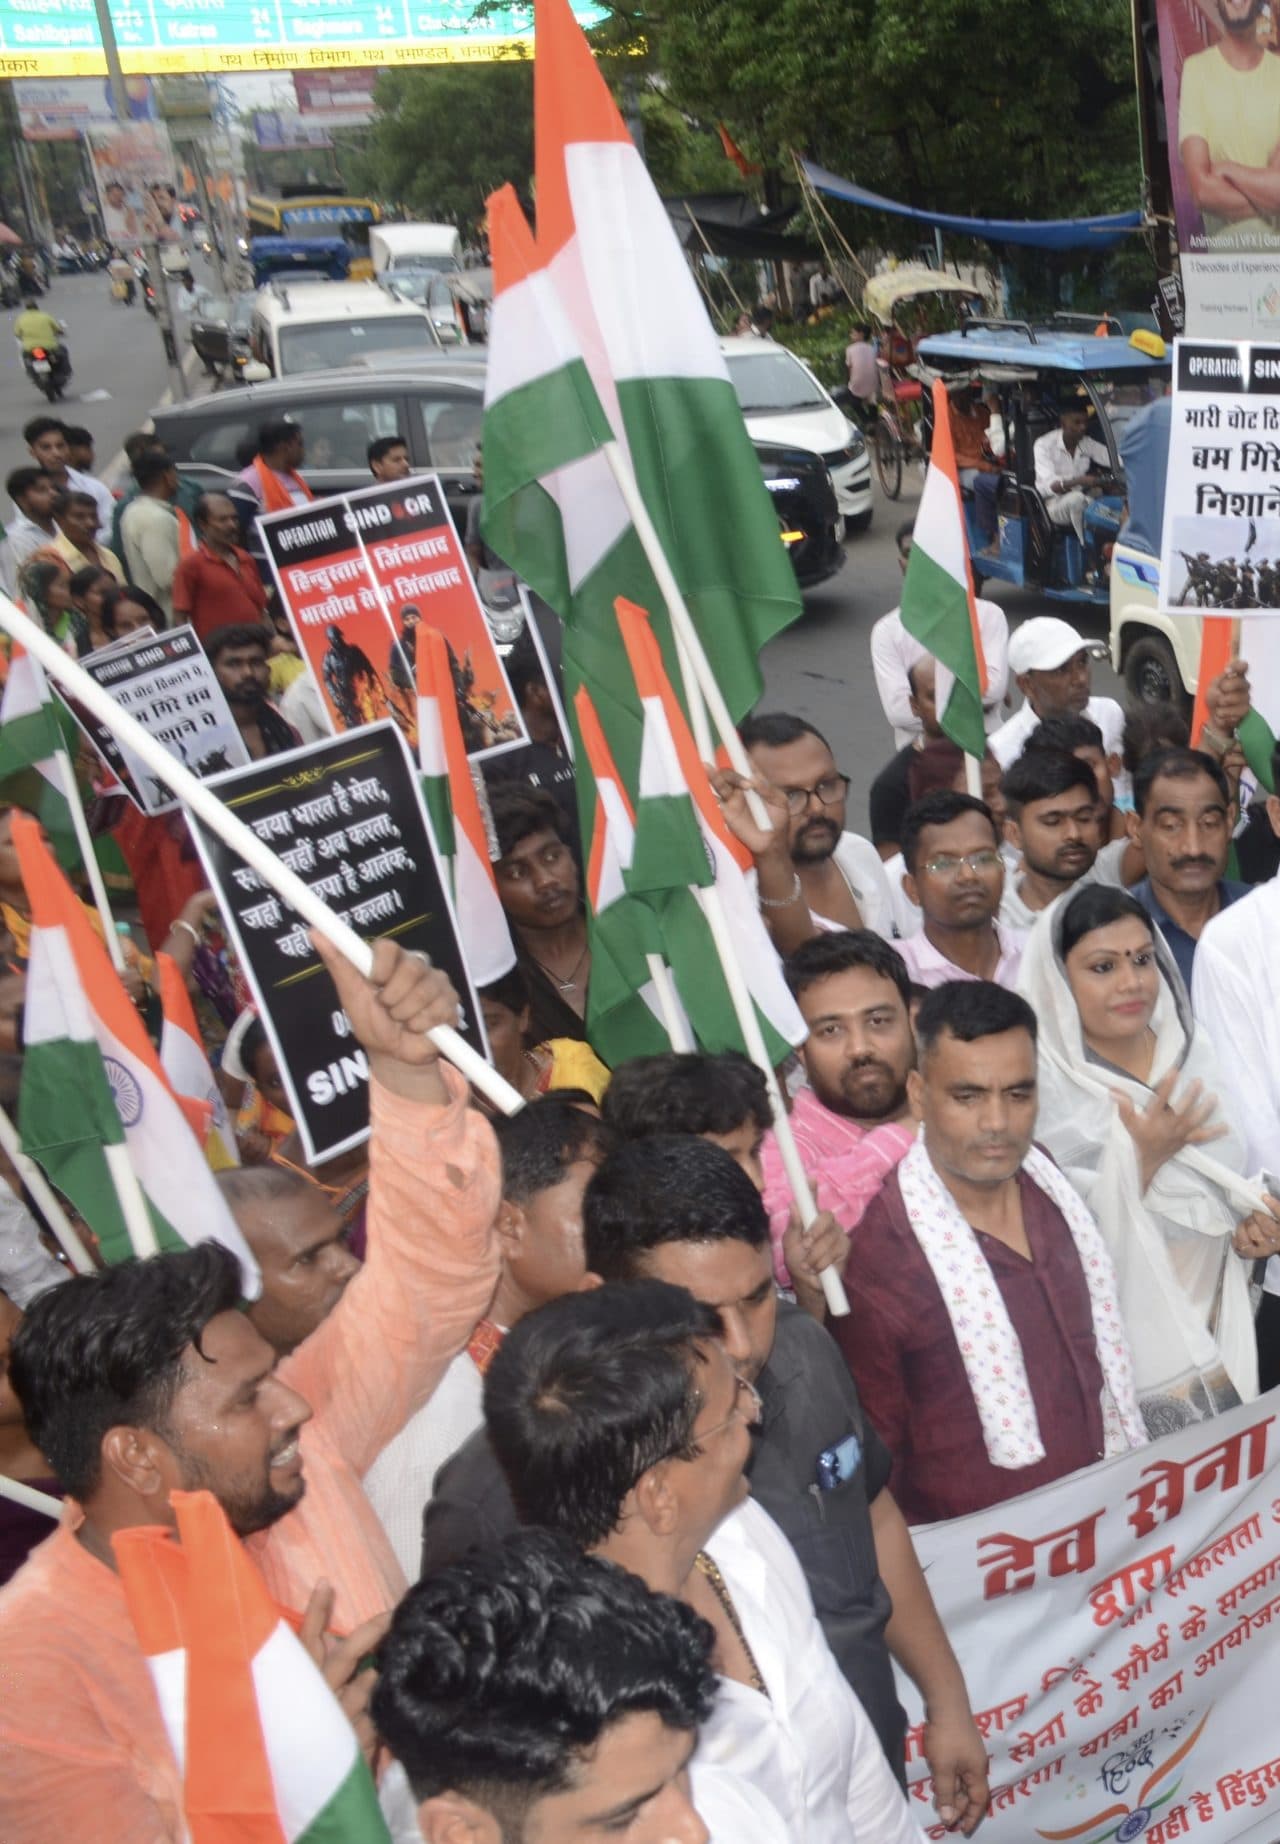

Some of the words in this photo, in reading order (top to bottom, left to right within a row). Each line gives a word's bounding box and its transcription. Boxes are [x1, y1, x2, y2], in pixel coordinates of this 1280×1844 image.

[286, 207, 366, 223] VINAY
[1189, 234, 1234, 249] Animation
[1189, 357, 1243, 378] OPERATION
[1185, 405, 1221, 429] मारी
[1227, 405, 1258, 430] चोट
[1192, 446, 1233, 471] बम
[277, 518, 338, 551] OPERATION
[373, 535, 450, 570] जिंदाबाद
[299, 595, 359, 625] भारतीय
[394, 567, 463, 600] जिंदाबाद
[252, 811, 294, 842] नया
[292, 792, 338, 827] भारत
[332, 781, 353, 816] है
[347, 776, 390, 804] मेरा,
[317, 829, 350, 861] अब
[345, 812, 402, 848] करता,
[341, 860, 361, 894] है
[358, 844, 417, 884] आतंक,
[351, 888, 404, 928] करता।
[1126, 1415, 1276, 1539] सेना
[1163, 1512, 1263, 1598] सफलता
[1089, 1544, 1176, 1627] द्वारा
[1008, 1711, 1067, 1763] सेना
[1073, 1678, 1103, 1718] के
[1112, 1622, 1170, 1691] शौर्य
[1180, 1605, 1208, 1642] के
[1148, 1669, 1183, 1710] का
[1187, 1789, 1215, 1824] है
